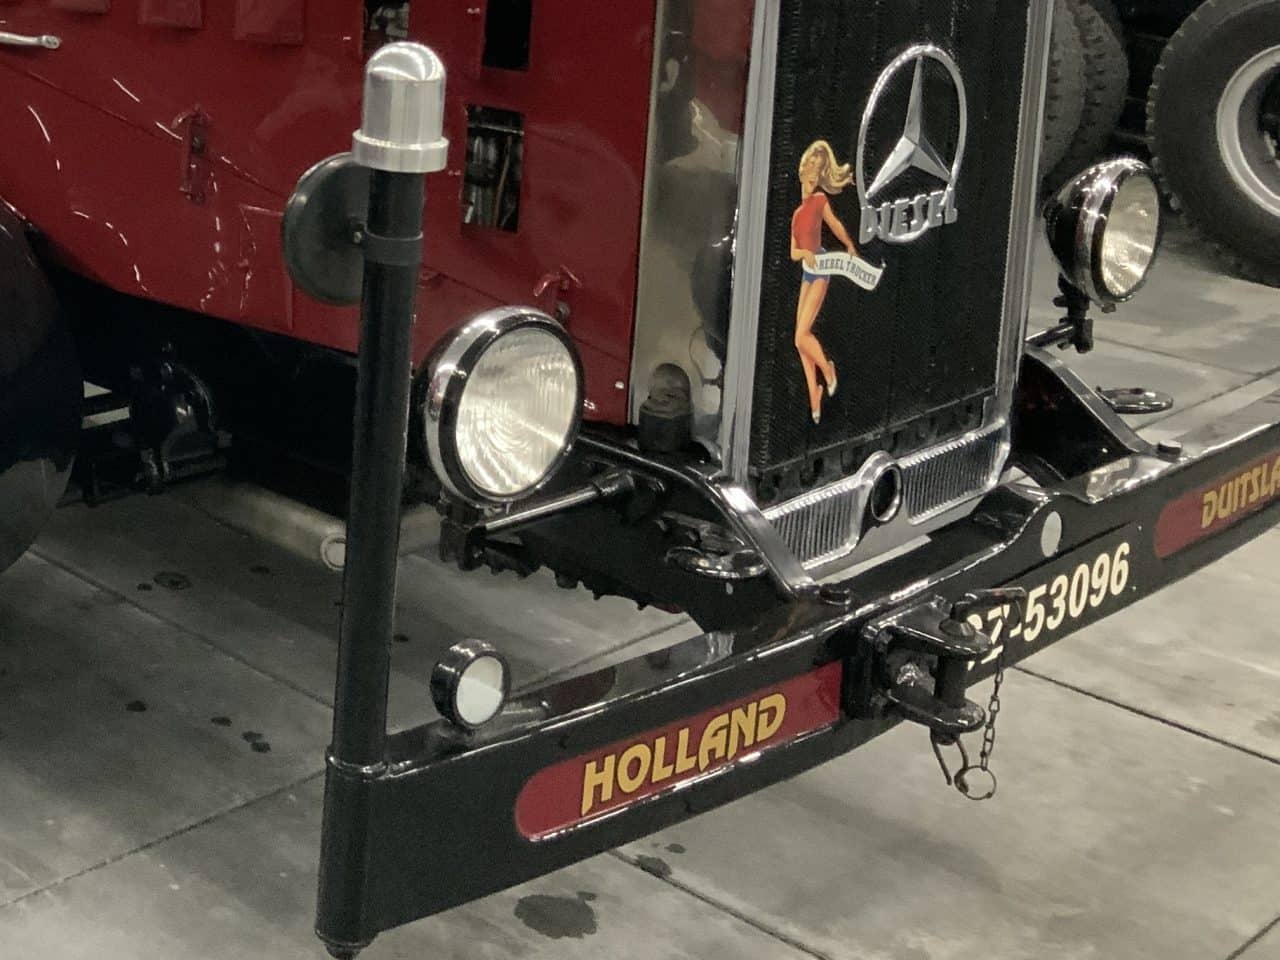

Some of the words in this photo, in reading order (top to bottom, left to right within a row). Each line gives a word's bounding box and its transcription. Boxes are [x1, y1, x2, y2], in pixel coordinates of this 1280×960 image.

[859, 191, 958, 244] DIESEL
[818, 258, 845, 271] REBEL
[846, 260, 877, 286] TRUCKER
[581, 693, 787, 817] HOLLAND
